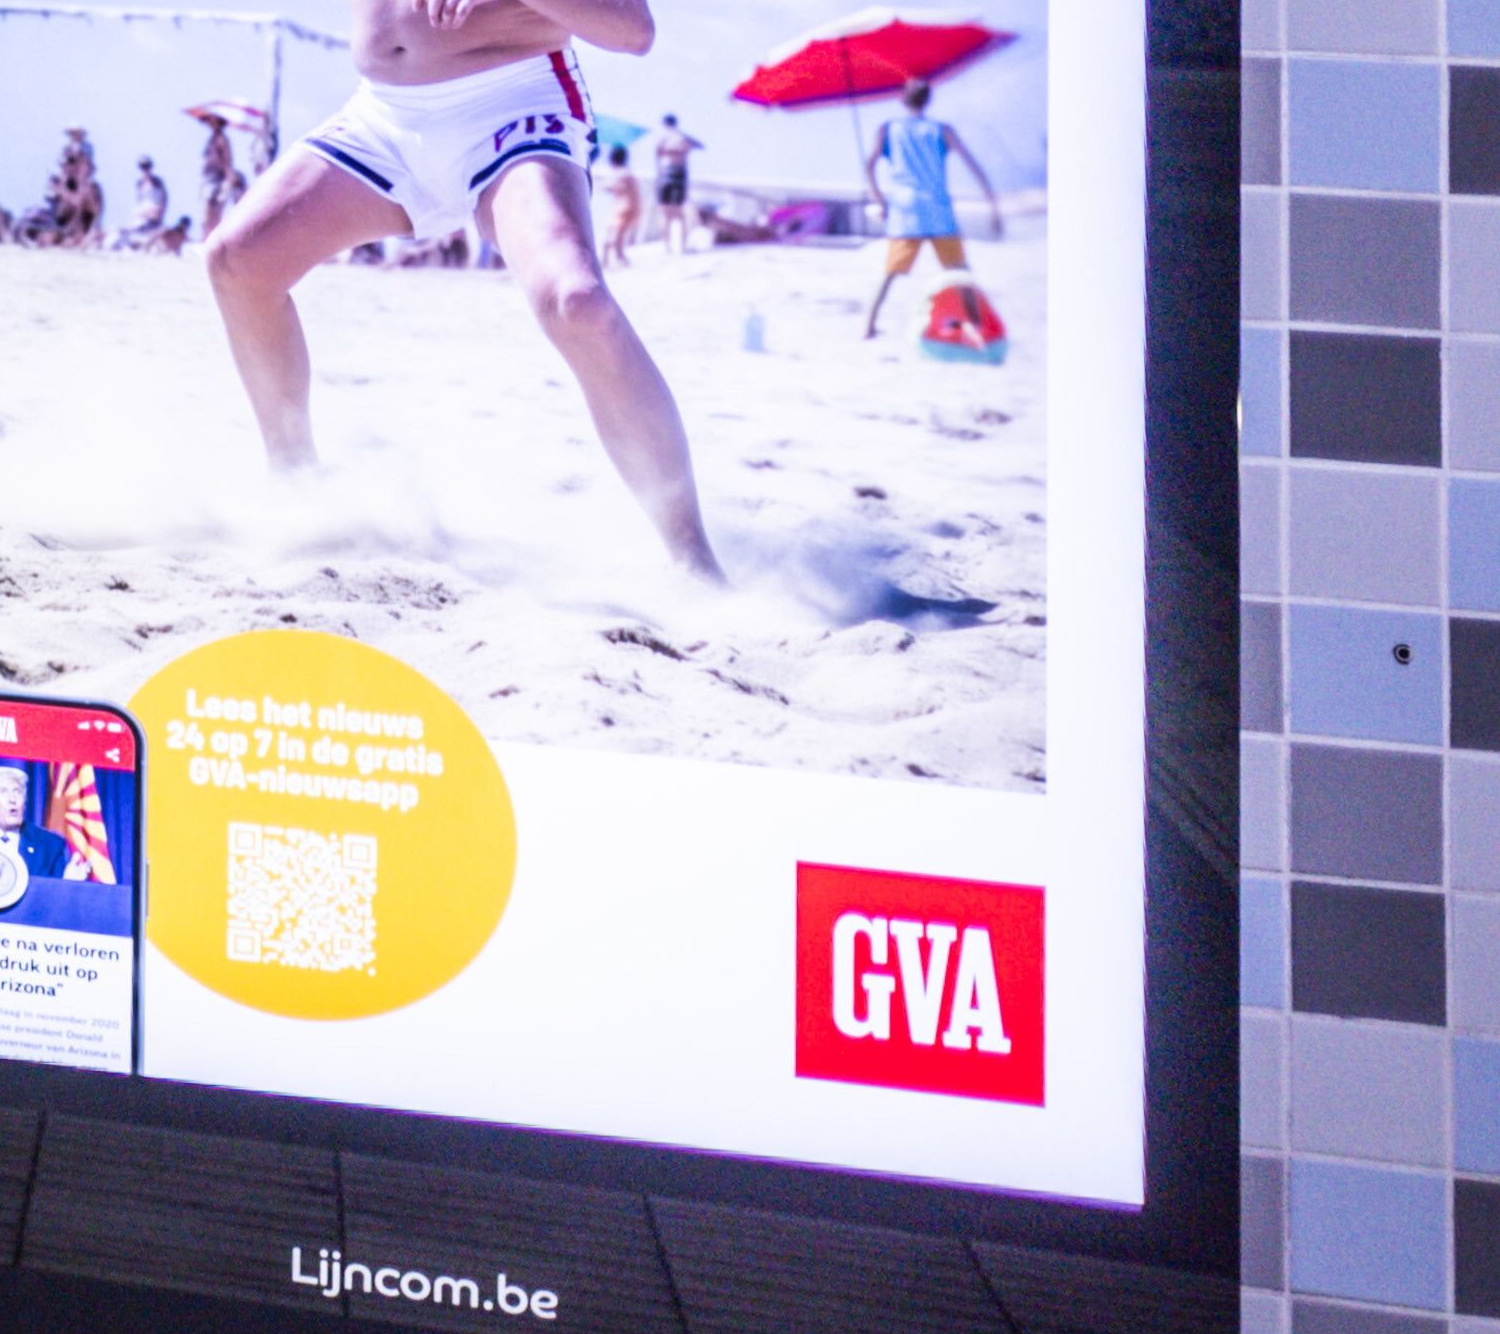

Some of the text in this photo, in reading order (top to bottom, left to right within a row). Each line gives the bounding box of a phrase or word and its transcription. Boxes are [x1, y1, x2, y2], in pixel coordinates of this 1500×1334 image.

[186, 688, 424, 739] Lees het nieuws
[166, 720, 444, 776] 24 op 7 in de gratis
[189, 756, 419, 812] GVA-nieuwsapp
[0, 956, 40, 974] druk
[46, 962, 70, 977] uit
[76, 968, 98, 982] op
[16, 940, 37, 951] na
[44, 942, 120, 962] verloren
[831, 910, 1012, 1056] GVA
[289, 1245, 560, 1320] Lijncom.be
